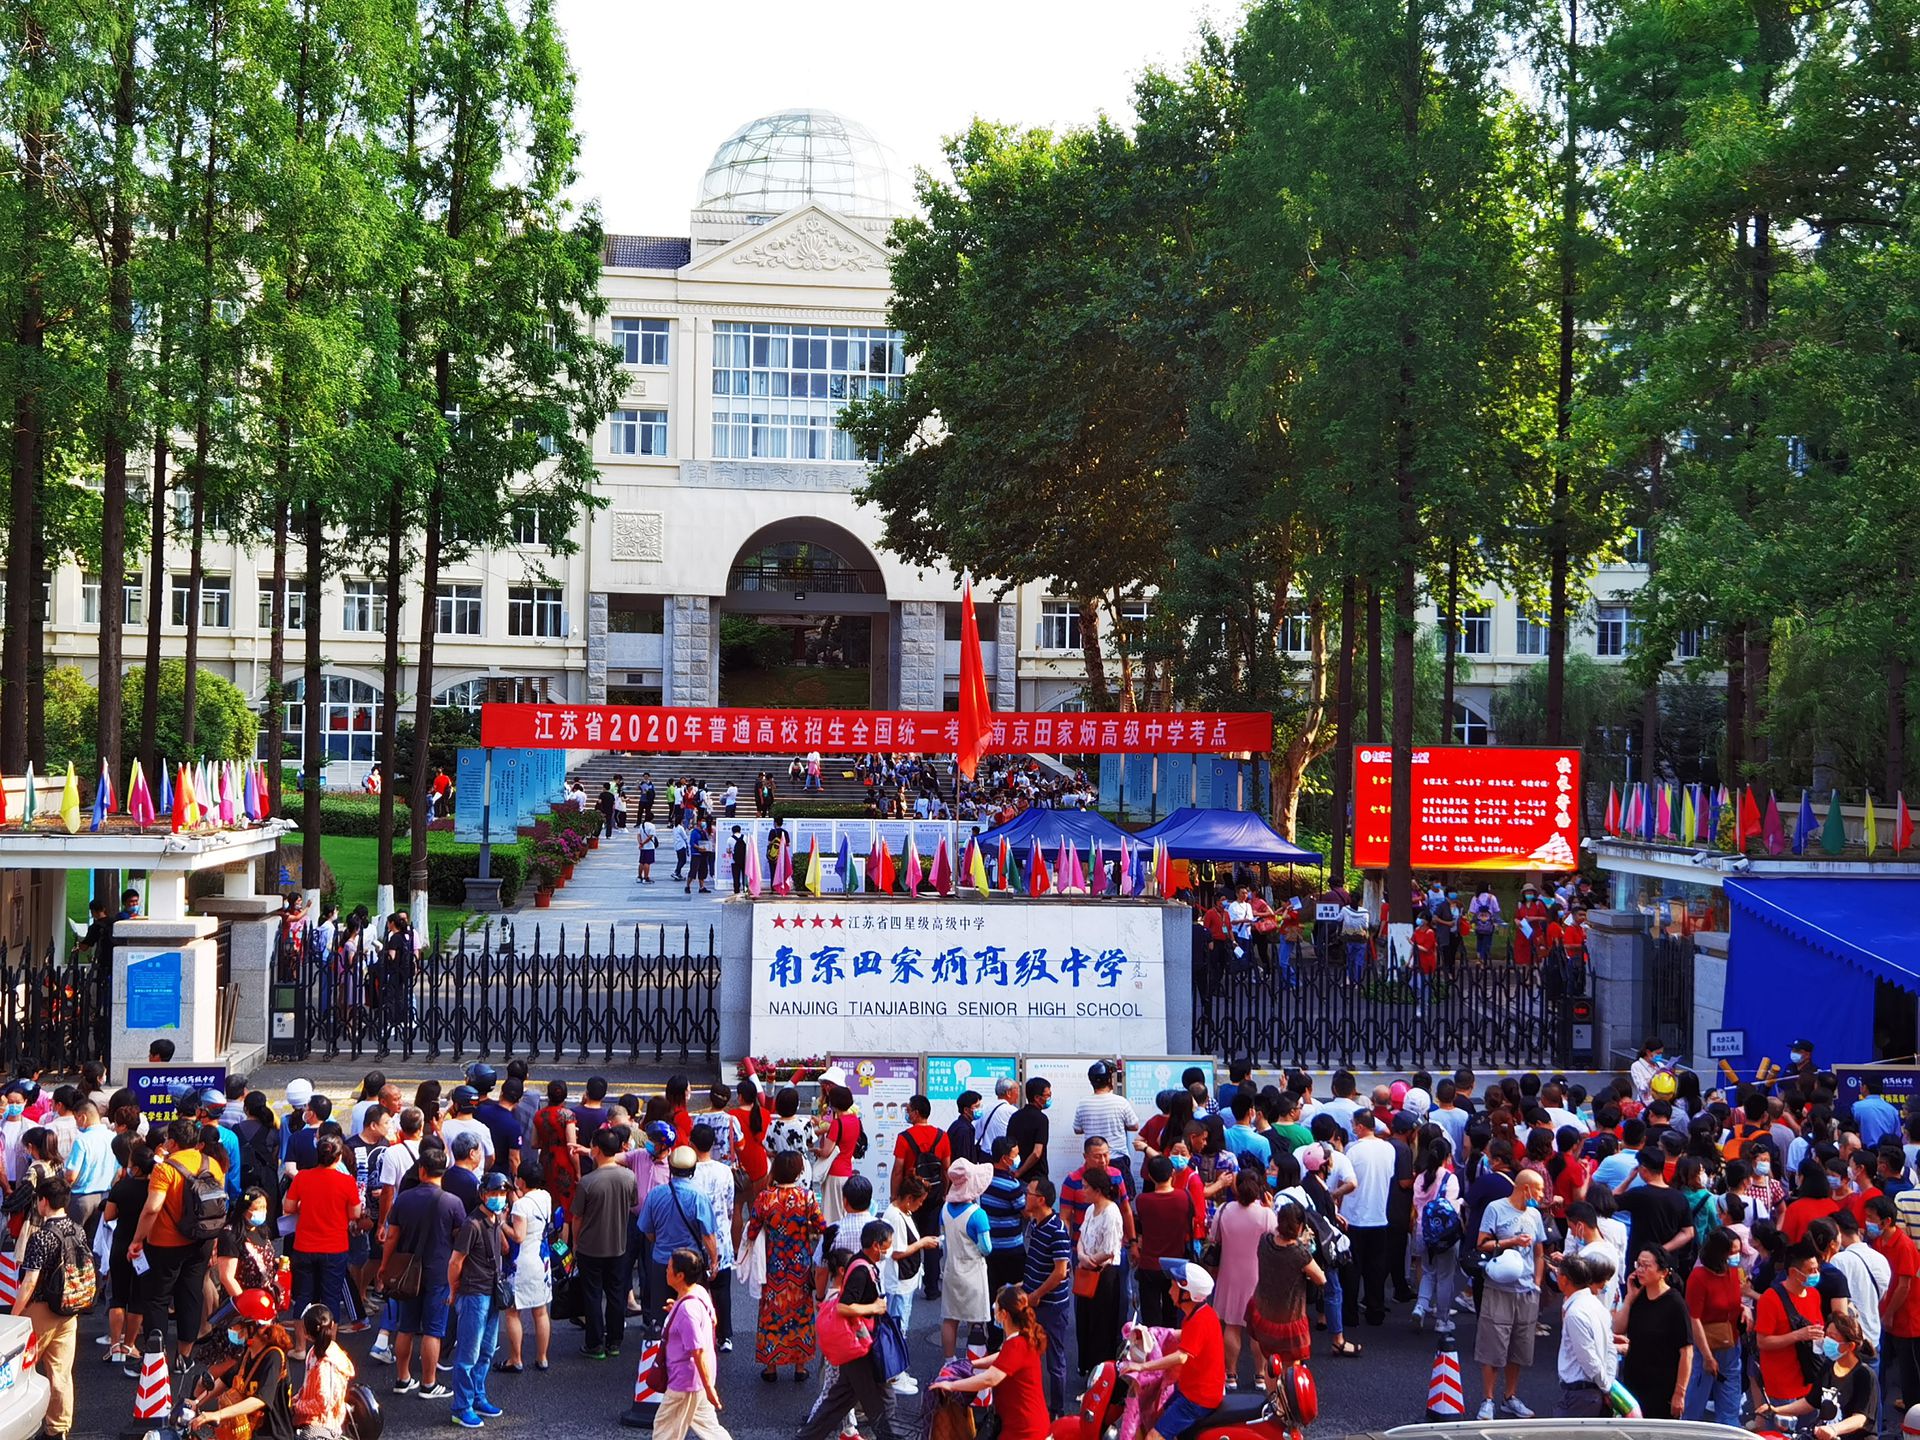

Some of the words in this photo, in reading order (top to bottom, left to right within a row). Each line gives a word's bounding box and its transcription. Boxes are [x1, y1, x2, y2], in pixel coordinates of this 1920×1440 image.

[848, 915, 985, 931] 江苏省四星级高级中学
[768, 945, 1128, 988] 南京田家炳高级中学
[769, 1001, 838, 1016] NANJING
[849, 1001, 947, 1017] TIANJIABING
[958, 1001, 1017, 1017] SENIOR
[1028, 1002, 1066, 1017] HIGH
[1076, 1002, 1143, 1017] SCHOOL
